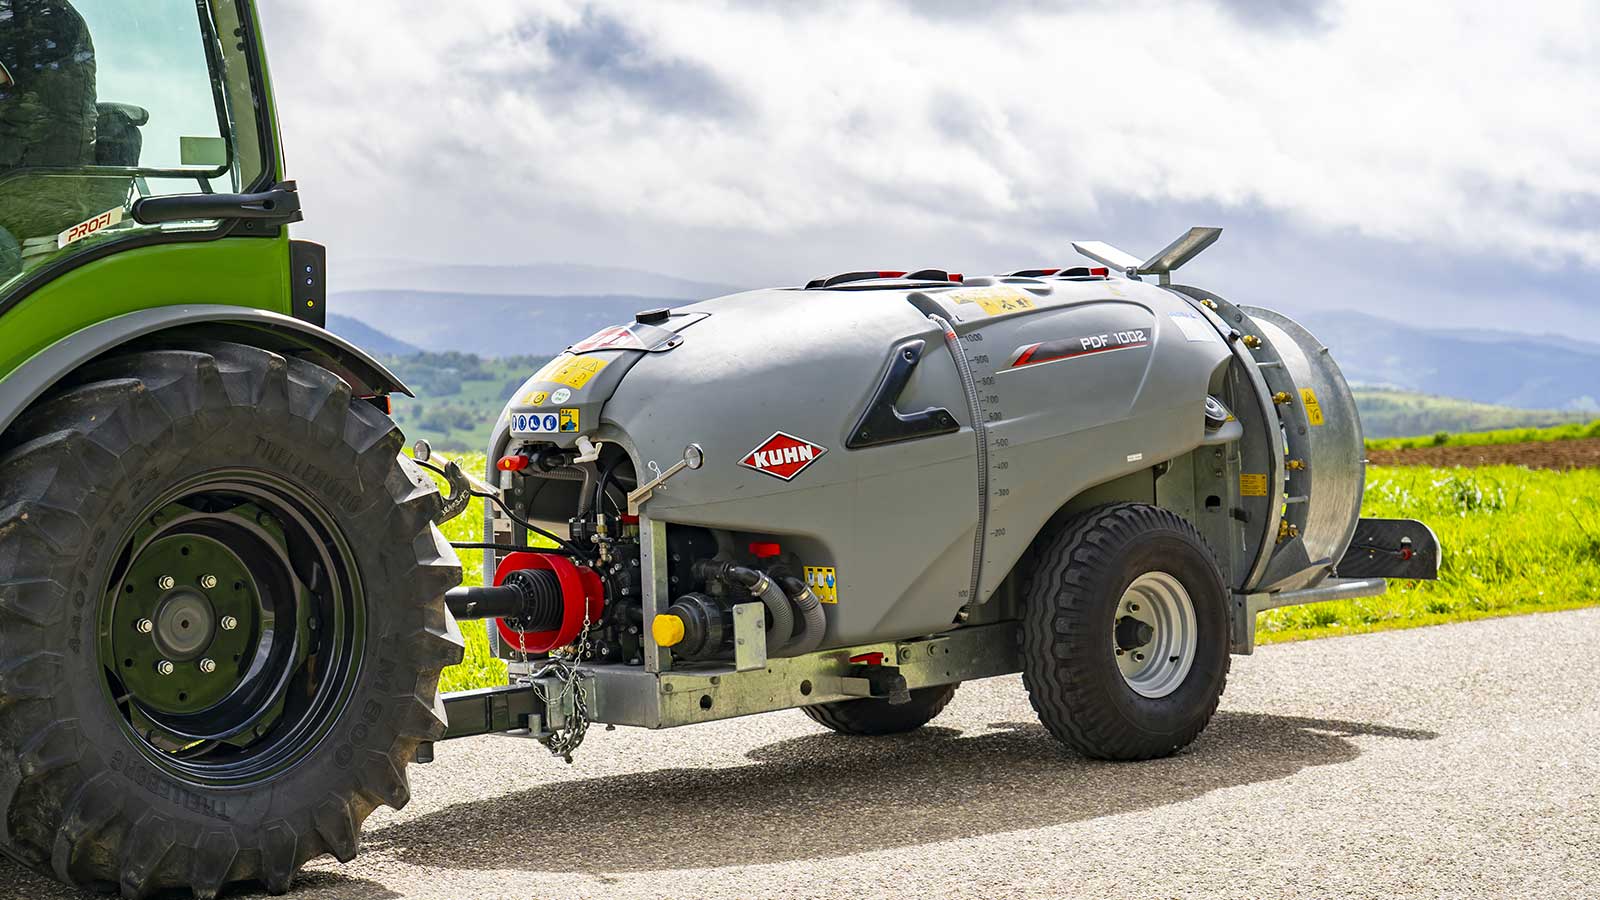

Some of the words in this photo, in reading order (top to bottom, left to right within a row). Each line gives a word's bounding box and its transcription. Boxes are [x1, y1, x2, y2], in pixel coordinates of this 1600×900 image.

[68, 212, 111, 242] PROFI
[964, 332, 983, 343] 1000
[1080, 334, 1108, 351] PDF
[1113, 330, 1147, 345] 1002
[753, 444, 814, 468] KUHN
[998, 488, 1010, 497] 300
[994, 527, 1006, 537] 200
